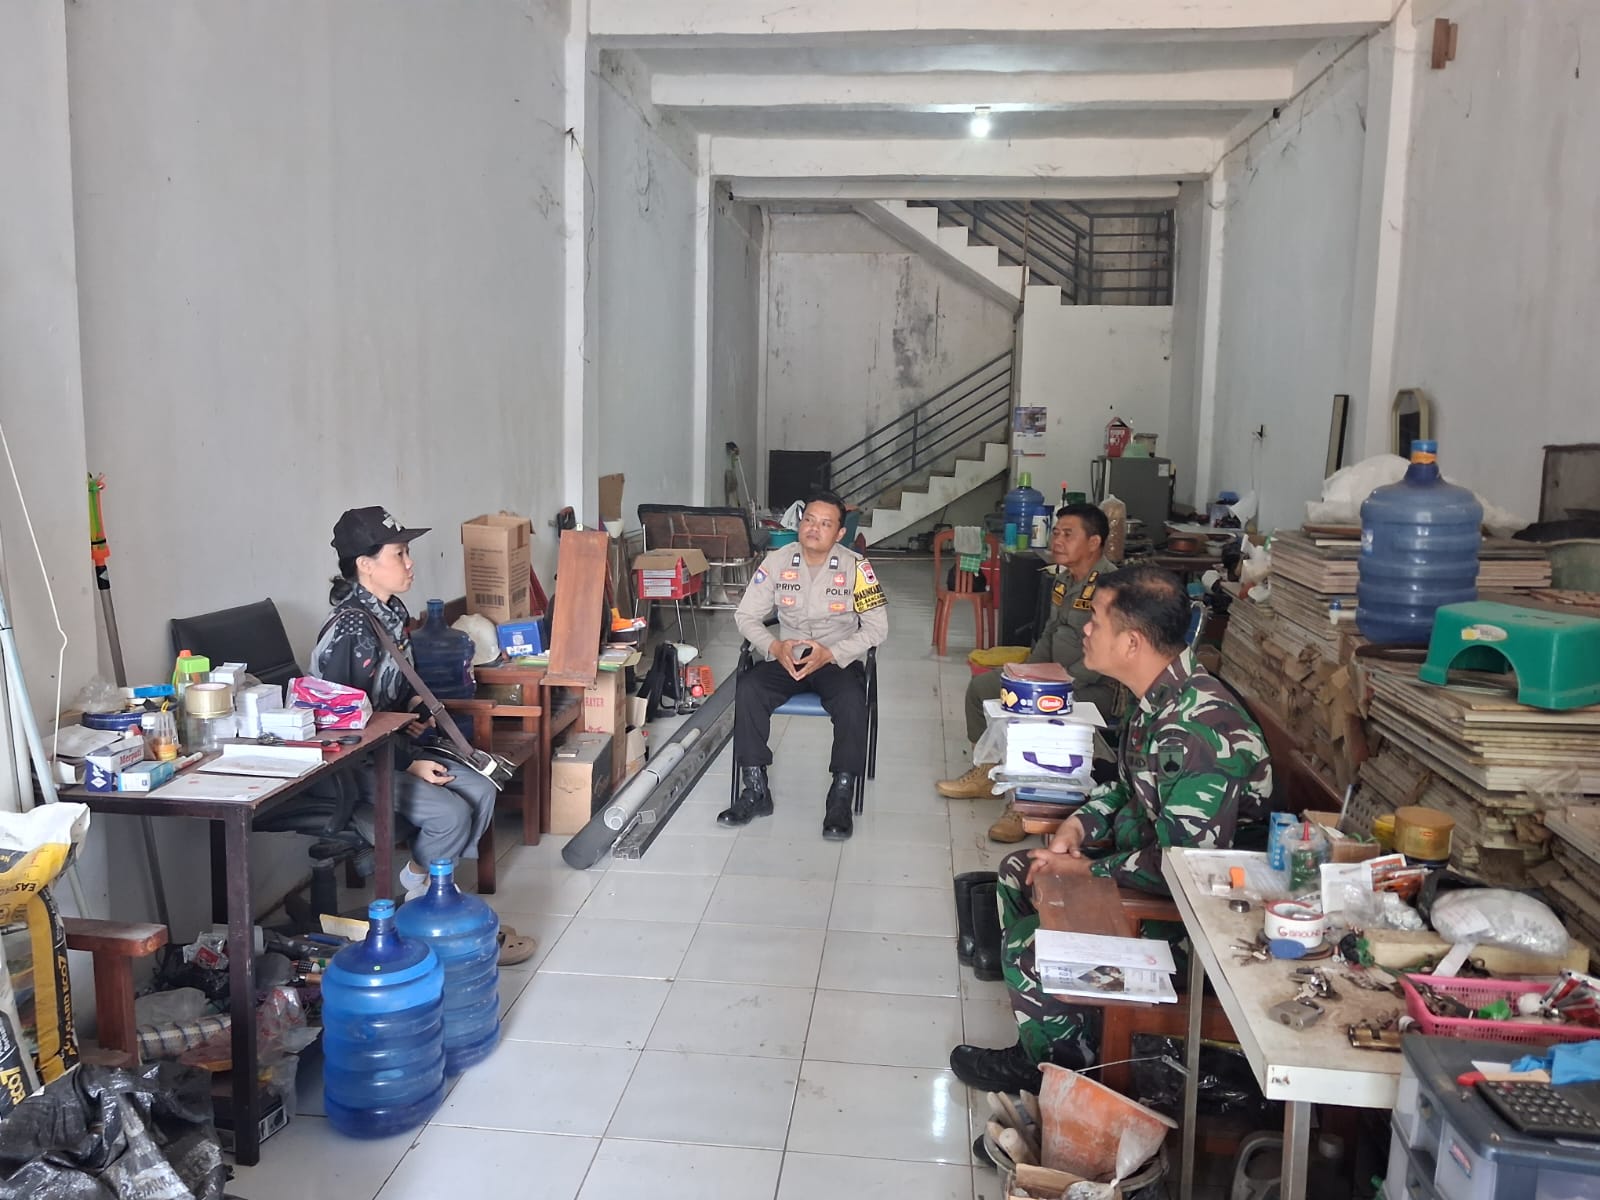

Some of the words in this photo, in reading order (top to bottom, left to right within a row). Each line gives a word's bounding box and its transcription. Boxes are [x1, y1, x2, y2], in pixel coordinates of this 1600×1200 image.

[776, 583, 801, 592] PRIYO
[825, 588, 850, 596] POLRI
[120, 749, 142, 763] Merpati
[0, 1066, 26, 1106] ECO7
